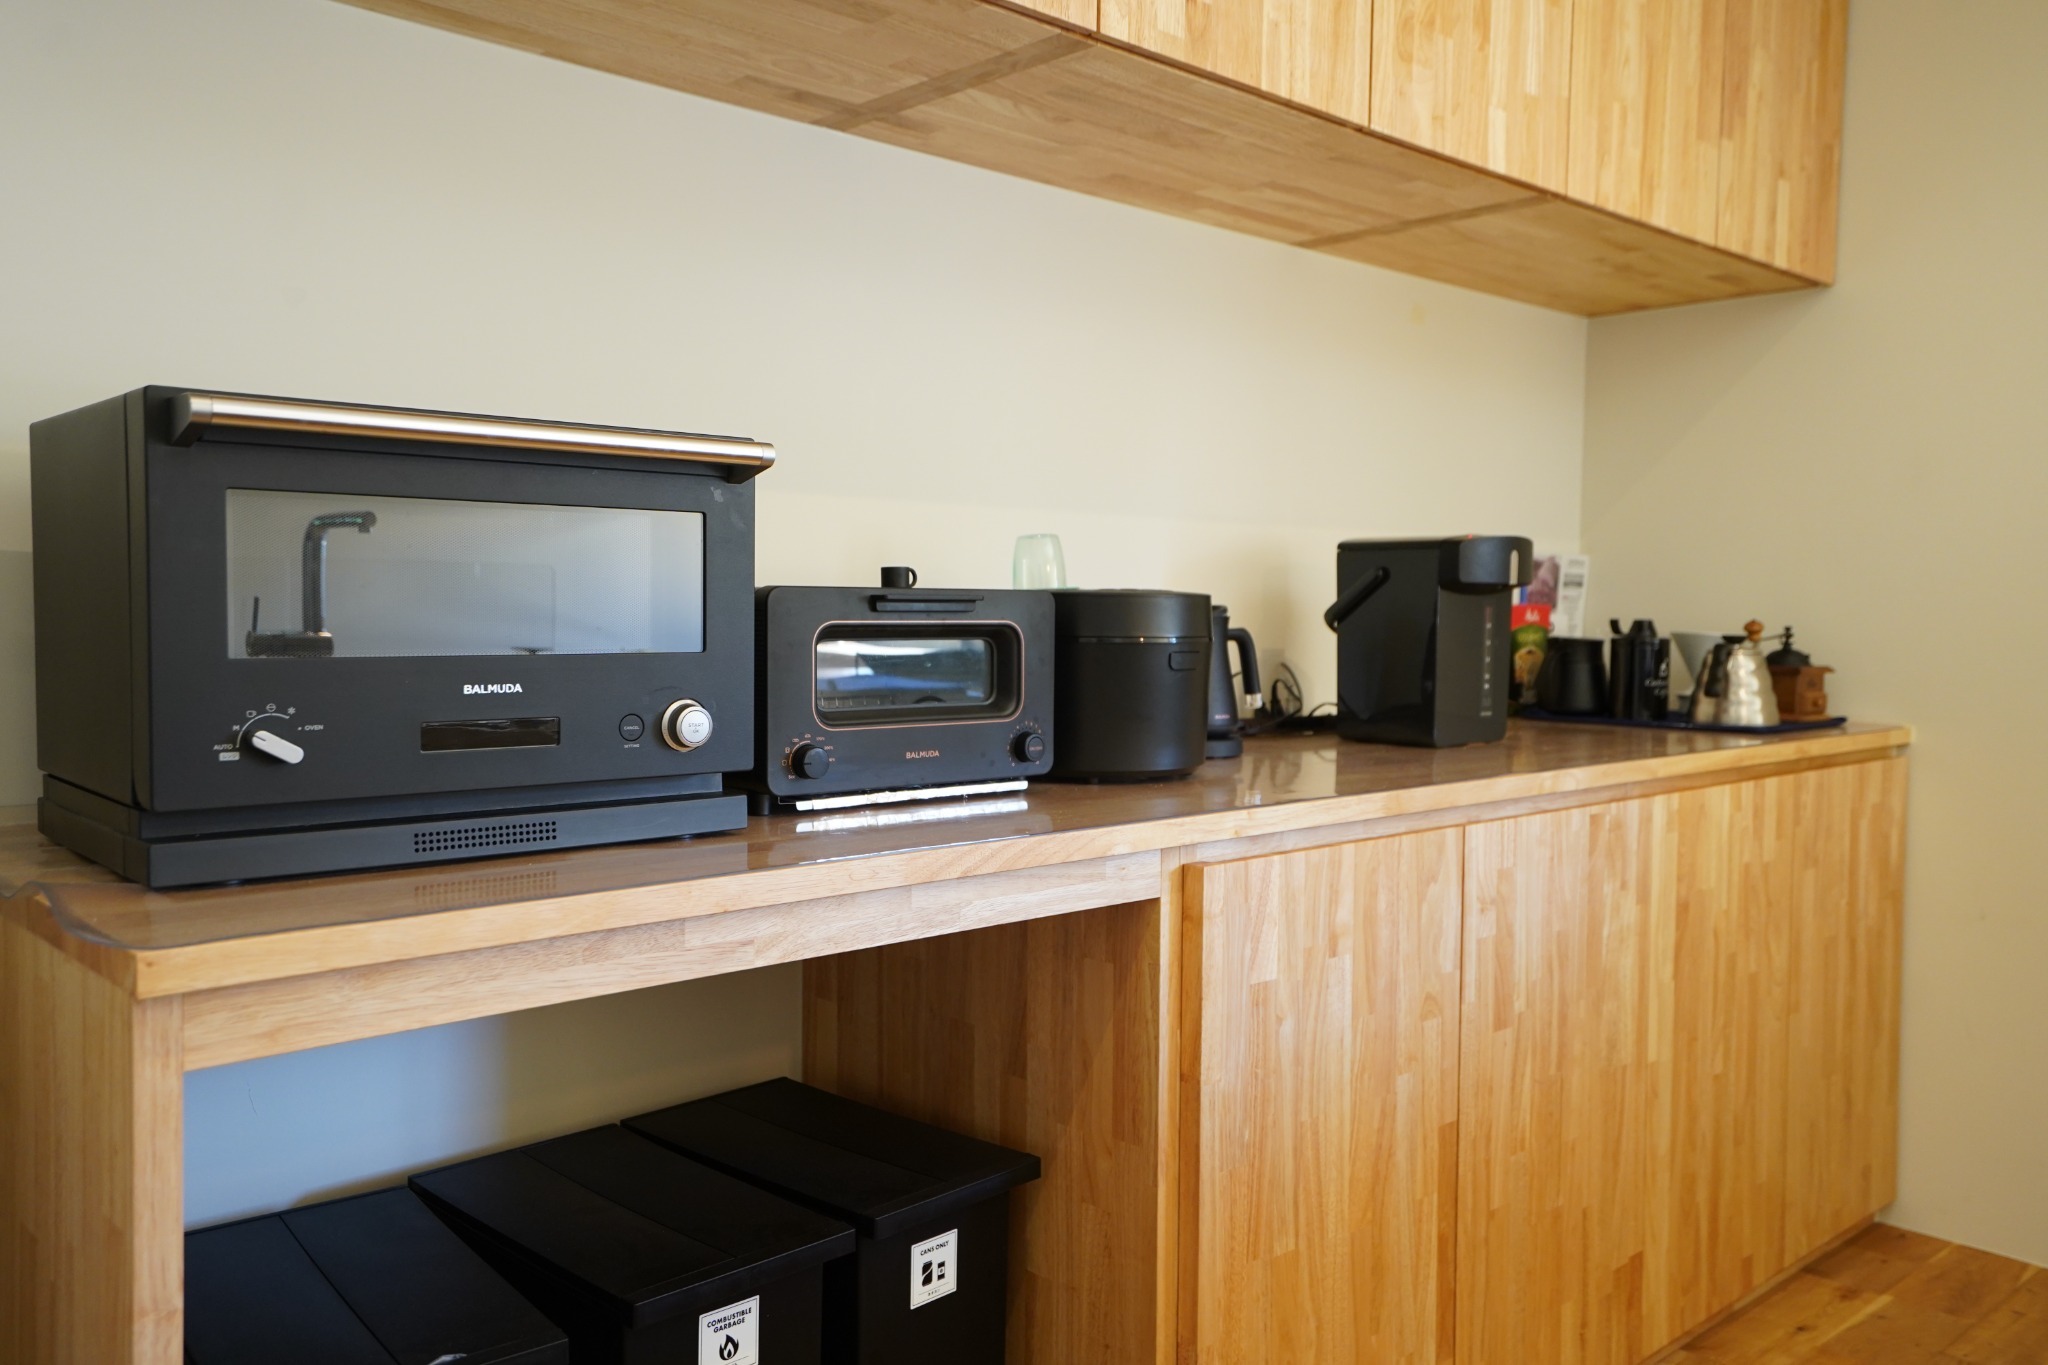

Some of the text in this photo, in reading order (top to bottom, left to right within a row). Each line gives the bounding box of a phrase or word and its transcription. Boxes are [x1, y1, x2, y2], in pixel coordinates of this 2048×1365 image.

[463, 683, 523, 694] BALMUDA
[213, 743, 233, 751] AUTO
[906, 750, 940, 760] BALMUDA
[920, 1240, 950, 1256] CANS ONLY
[706, 1307, 752, 1328] COMBUSTIBLE
[713, 1317, 746, 1333] GARBAGE
